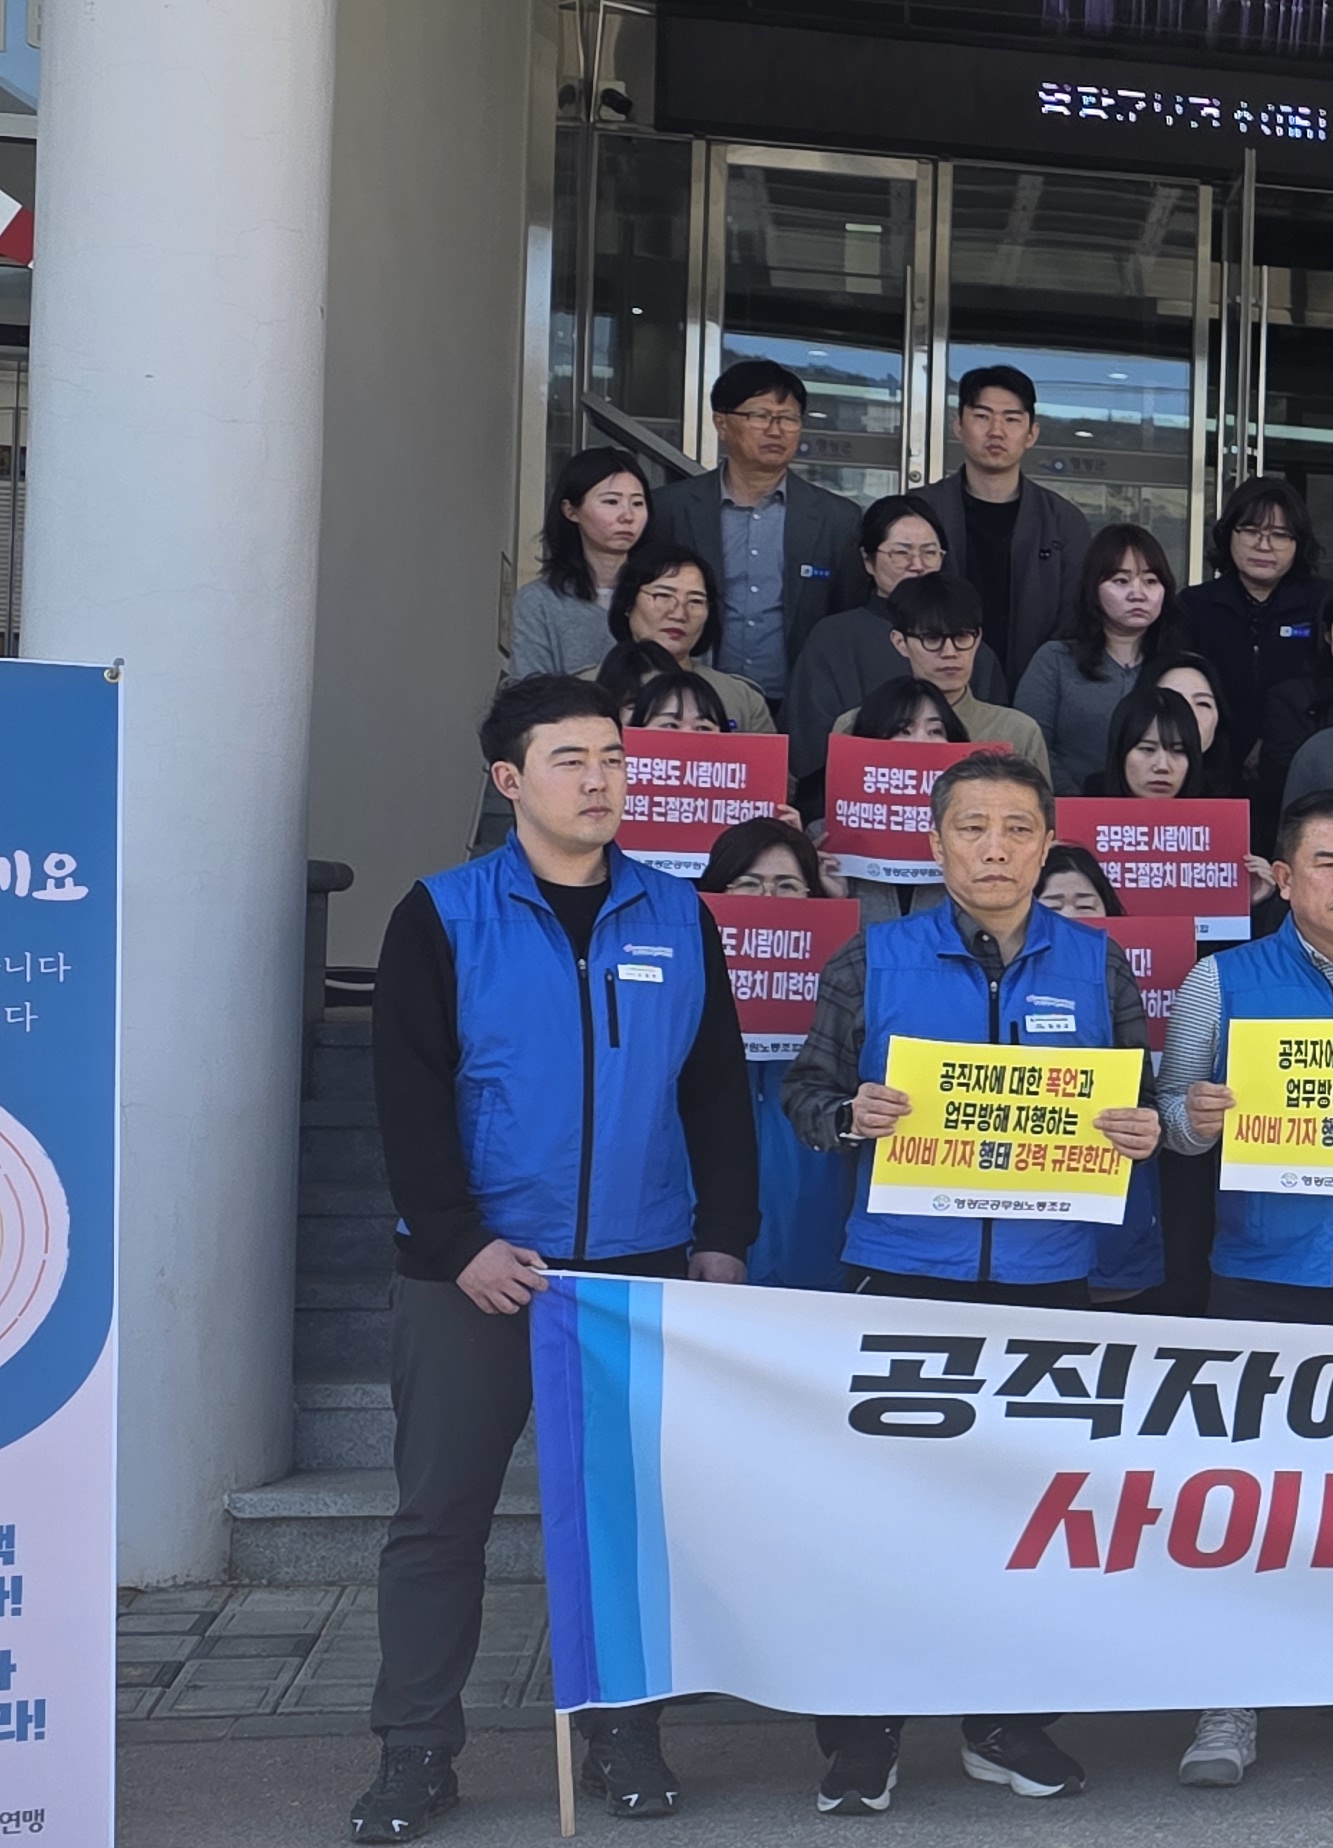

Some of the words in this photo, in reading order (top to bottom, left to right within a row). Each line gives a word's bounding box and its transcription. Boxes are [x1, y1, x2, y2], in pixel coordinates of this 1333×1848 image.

[625, 756, 681, 786] 공무원도
[683, 760, 746, 789] 사람이다!
[863, 766, 918, 795] 공무원도
[652, 796, 709, 823] 근절장치
[836, 799, 887, 830] 악성민원
[890, 805, 936, 832] 근절장
[1096, 825, 1149, 852] 공무원도
[1152, 826, 1210, 852] 사람이다!
[1124, 862, 1177, 888] 근절장치
[1180, 862, 1238, 888] 마련하라!
[740, 928, 811, 959] 사람이다!
[0, 951, 72, 983] 니다
[939, 1061, 1006, 1096] 공직자에
[1008, 1065, 1043, 1097] 대한
[1045, 1067, 1094, 1099] 폭언과
[944, 1101, 1009, 1134] 업무방해
[1012, 1104, 1079, 1136] 자행하는
[1234, 1114, 1282, 1146] 사이비
[1286, 1114, 1317, 1146] 기자
[886, 1134, 937, 1168] 사이비
[940, 1137, 975, 1169] 기자
[978, 1139, 1011, 1171] 행태
[1014, 1142, 1048, 1173] 강력
[1051, 1144, 1120, 1177] 규탄한다!
[0, 1809, 45, 1836] 연맹
